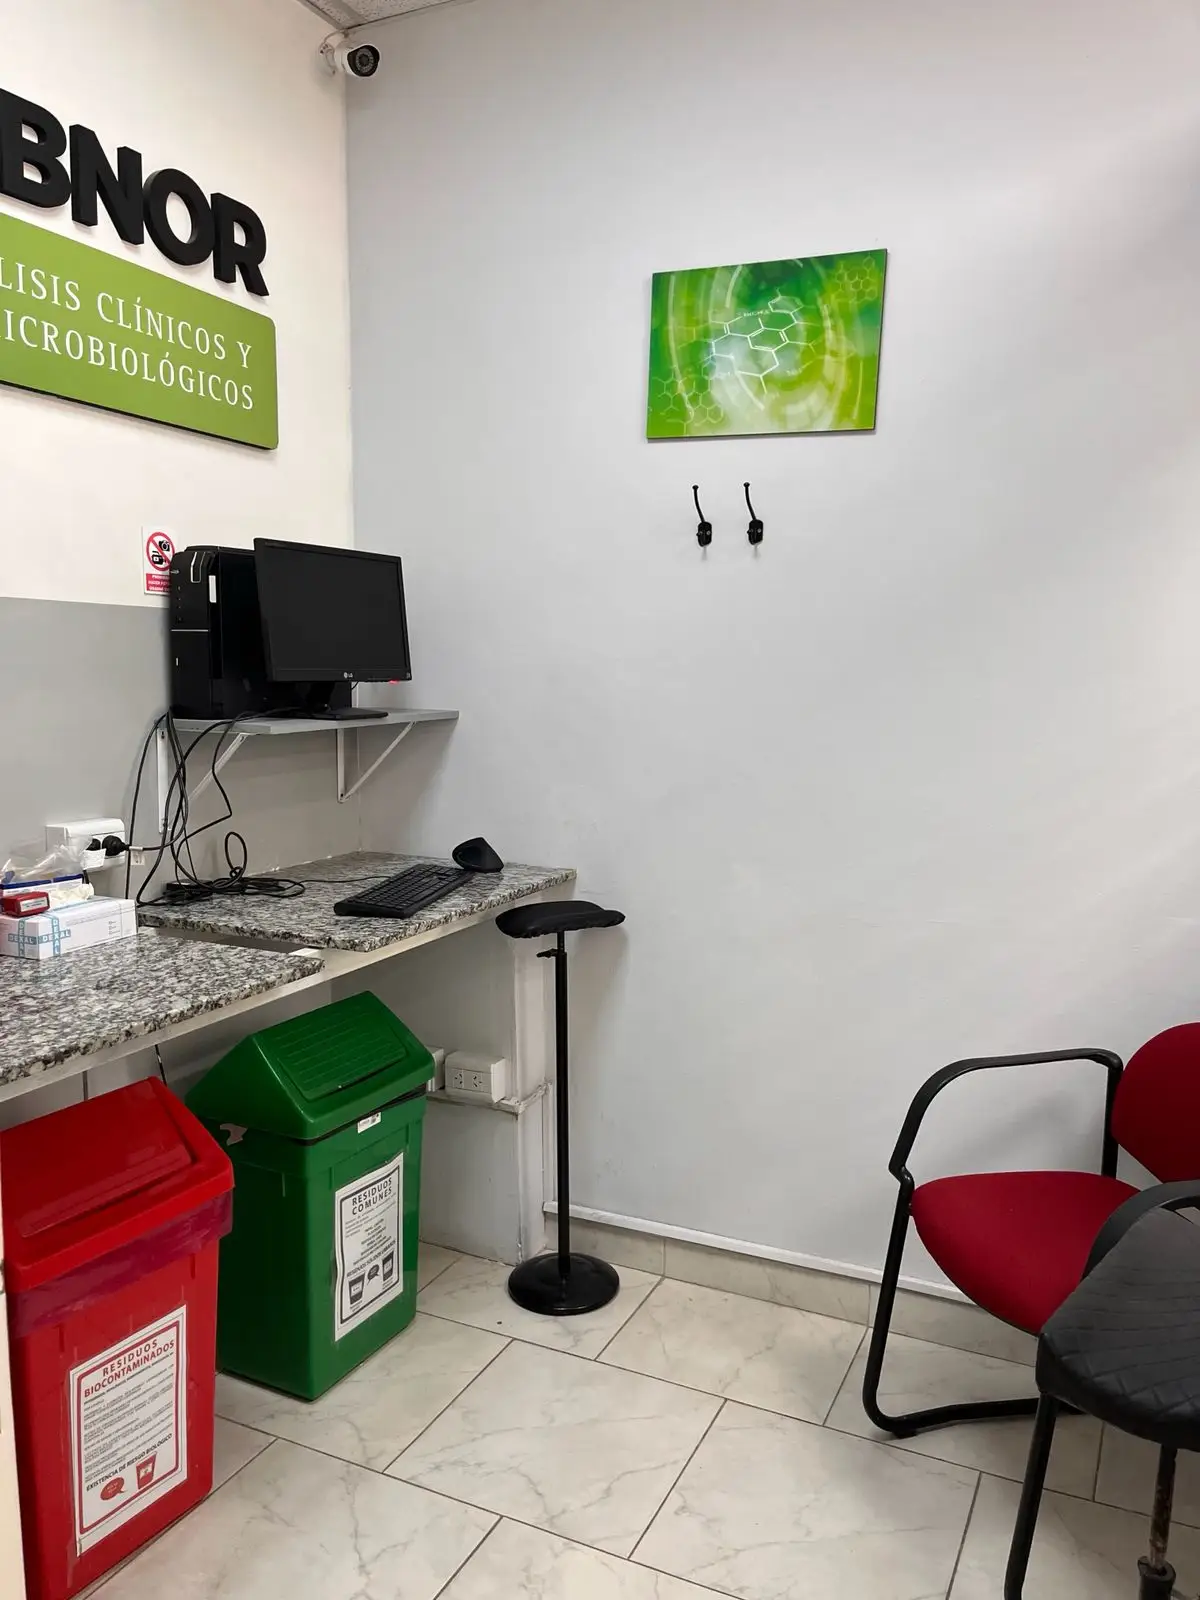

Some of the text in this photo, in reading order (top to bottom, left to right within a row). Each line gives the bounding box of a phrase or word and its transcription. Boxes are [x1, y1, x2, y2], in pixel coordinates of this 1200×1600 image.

[0, 88, 269, 296] BNOR
[0, 256, 252, 369] LISIS CLÍNICOS Y
[0, 309, 253, 410] ICROBIOLÓGICOS
[9, 934, 35, 945] DEXAL
[42, 930, 71, 943] DEXAL
[352, 1176, 392, 1206] RESIDUOS
[352, 1187, 392, 1215] COMUNES
[84, 1340, 174, 1398] BIOCONTAMINADOS
[102, 1339, 158, 1377] RESIDUOS
[86, 1469, 118, 1492] EXISTENCIA
